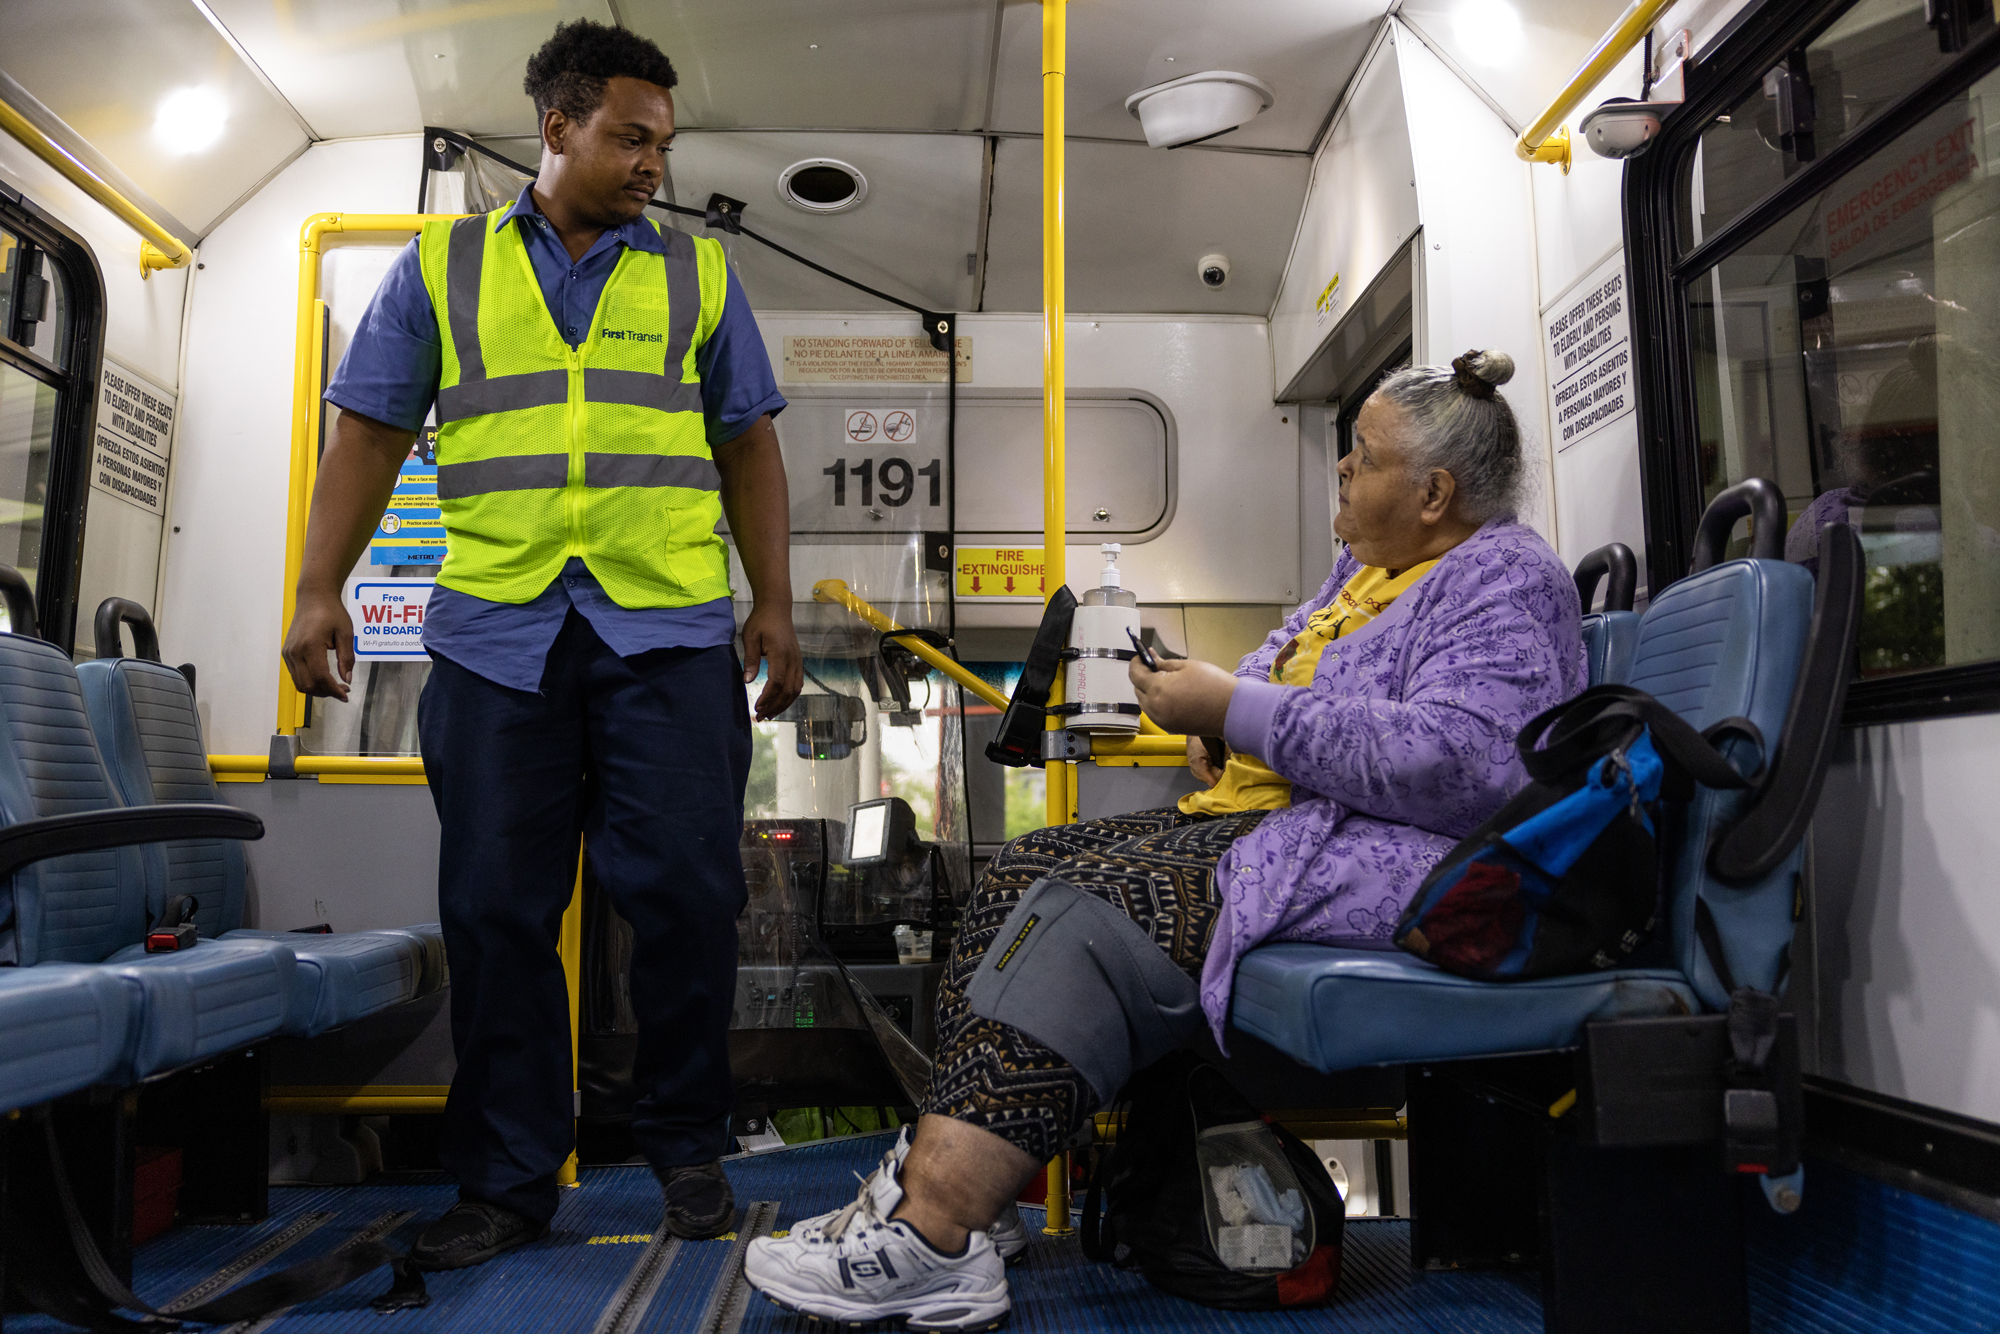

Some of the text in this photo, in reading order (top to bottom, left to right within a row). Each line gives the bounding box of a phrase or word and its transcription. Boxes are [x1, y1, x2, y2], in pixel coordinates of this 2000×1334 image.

[1826, 117, 1977, 235] EMERGENCY EXIT
[1830, 152, 1980, 260] SALIDA DE EMERGENCIA
[1549, 273, 1622, 341] PLEASE OFFER THESE SEATS
[1553, 296, 1621, 358] TO ELDERLY AND PERSONS
[602, 328, 663, 343] First Transit
[793, 338, 934, 348] NO STANDING FORWARD OF YELL
[794, 350, 962, 359] NO PIE DELANTE DE LA LINEA AMARILA
[1563, 324, 1612, 370] WITH DISABILITIES
[103, 369, 173, 421] PLEASE OFFER THESE SEATS
[1555, 349, 1628, 407] OFREZCA ESTOS ASIENTOS
[1558, 370, 1627, 425] A PERSONAS MAYORES Y
[104, 388, 169, 436] TO ELDERLY AND PERSONS
[111, 411, 157, 447] WITH DISABILITIES
[1562, 394, 1624, 441] CON DISCAPACIDADES
[96, 434, 165, 477] OFREZCA ESTOS ASIENTOS
[96, 452, 162, 493] A PERSONAS MAYORES Y
[99, 471, 157, 507] CON DISCAPACIDADES
[822, 457, 941, 507] 1191
[962, 563, 1045, 576] EXTINGUISHE
[995, 550, 1025, 562] FIRE
[361, 604, 423, 624] Wi-Fi
[382, 593, 405, 602] Free
[363, 625, 423, 635] ON BOARD
[378, 640, 400, 648] gratuito
